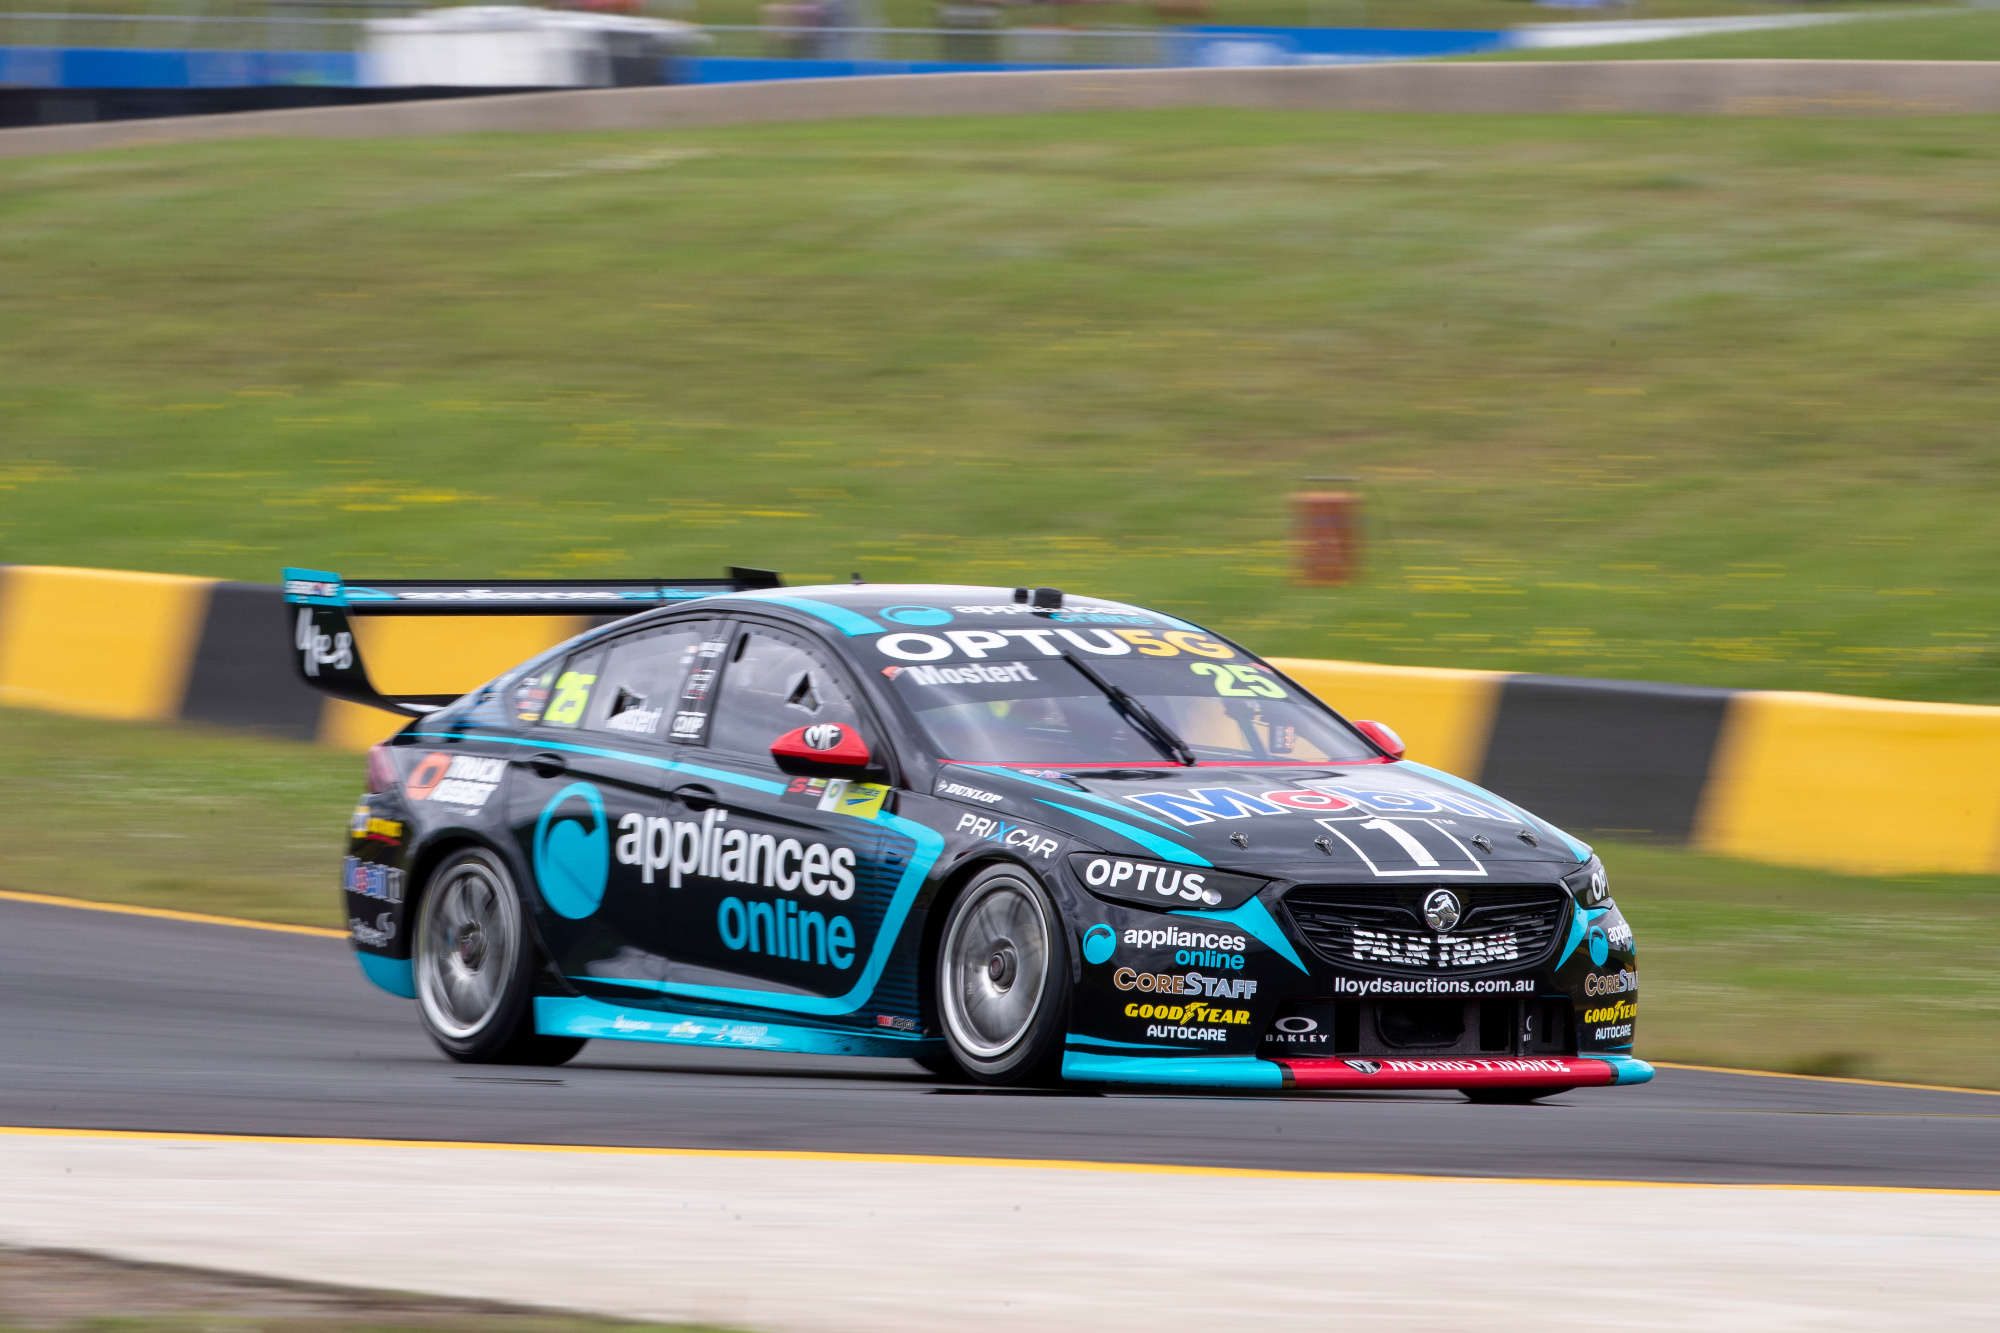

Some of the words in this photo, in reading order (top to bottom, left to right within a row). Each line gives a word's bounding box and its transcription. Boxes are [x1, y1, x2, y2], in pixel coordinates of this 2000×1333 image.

[907, 661, 1039, 686] Mostert
[1190, 662, 1288, 699] 25
[543, 671, 598, 725] 25
[946, 782, 1003, 804] DUNLOP
[1122, 786, 1524, 827] Mobil
[955, 812, 1060, 860] PRIXCAR
[1359, 818, 1441, 868] 1
[615, 807, 857, 901] appliances
[1085, 858, 1206, 901] OPTUS
[717, 896, 857, 970] online
[1123, 926, 1246, 952] appliances
[1174, 949, 1245, 970] online
[1334, 977, 1536, 996] lloydsauctions.com.au
[1146, 1024, 1227, 1042] AUTOCARE
[1265, 1034, 1328, 1043] OAKLEY
[1595, 1023, 1632, 1041] AUTOCARE
[1383, 1060, 1478, 1072] MORRIS
[1477, 1060, 1571, 1073] FINANCE
